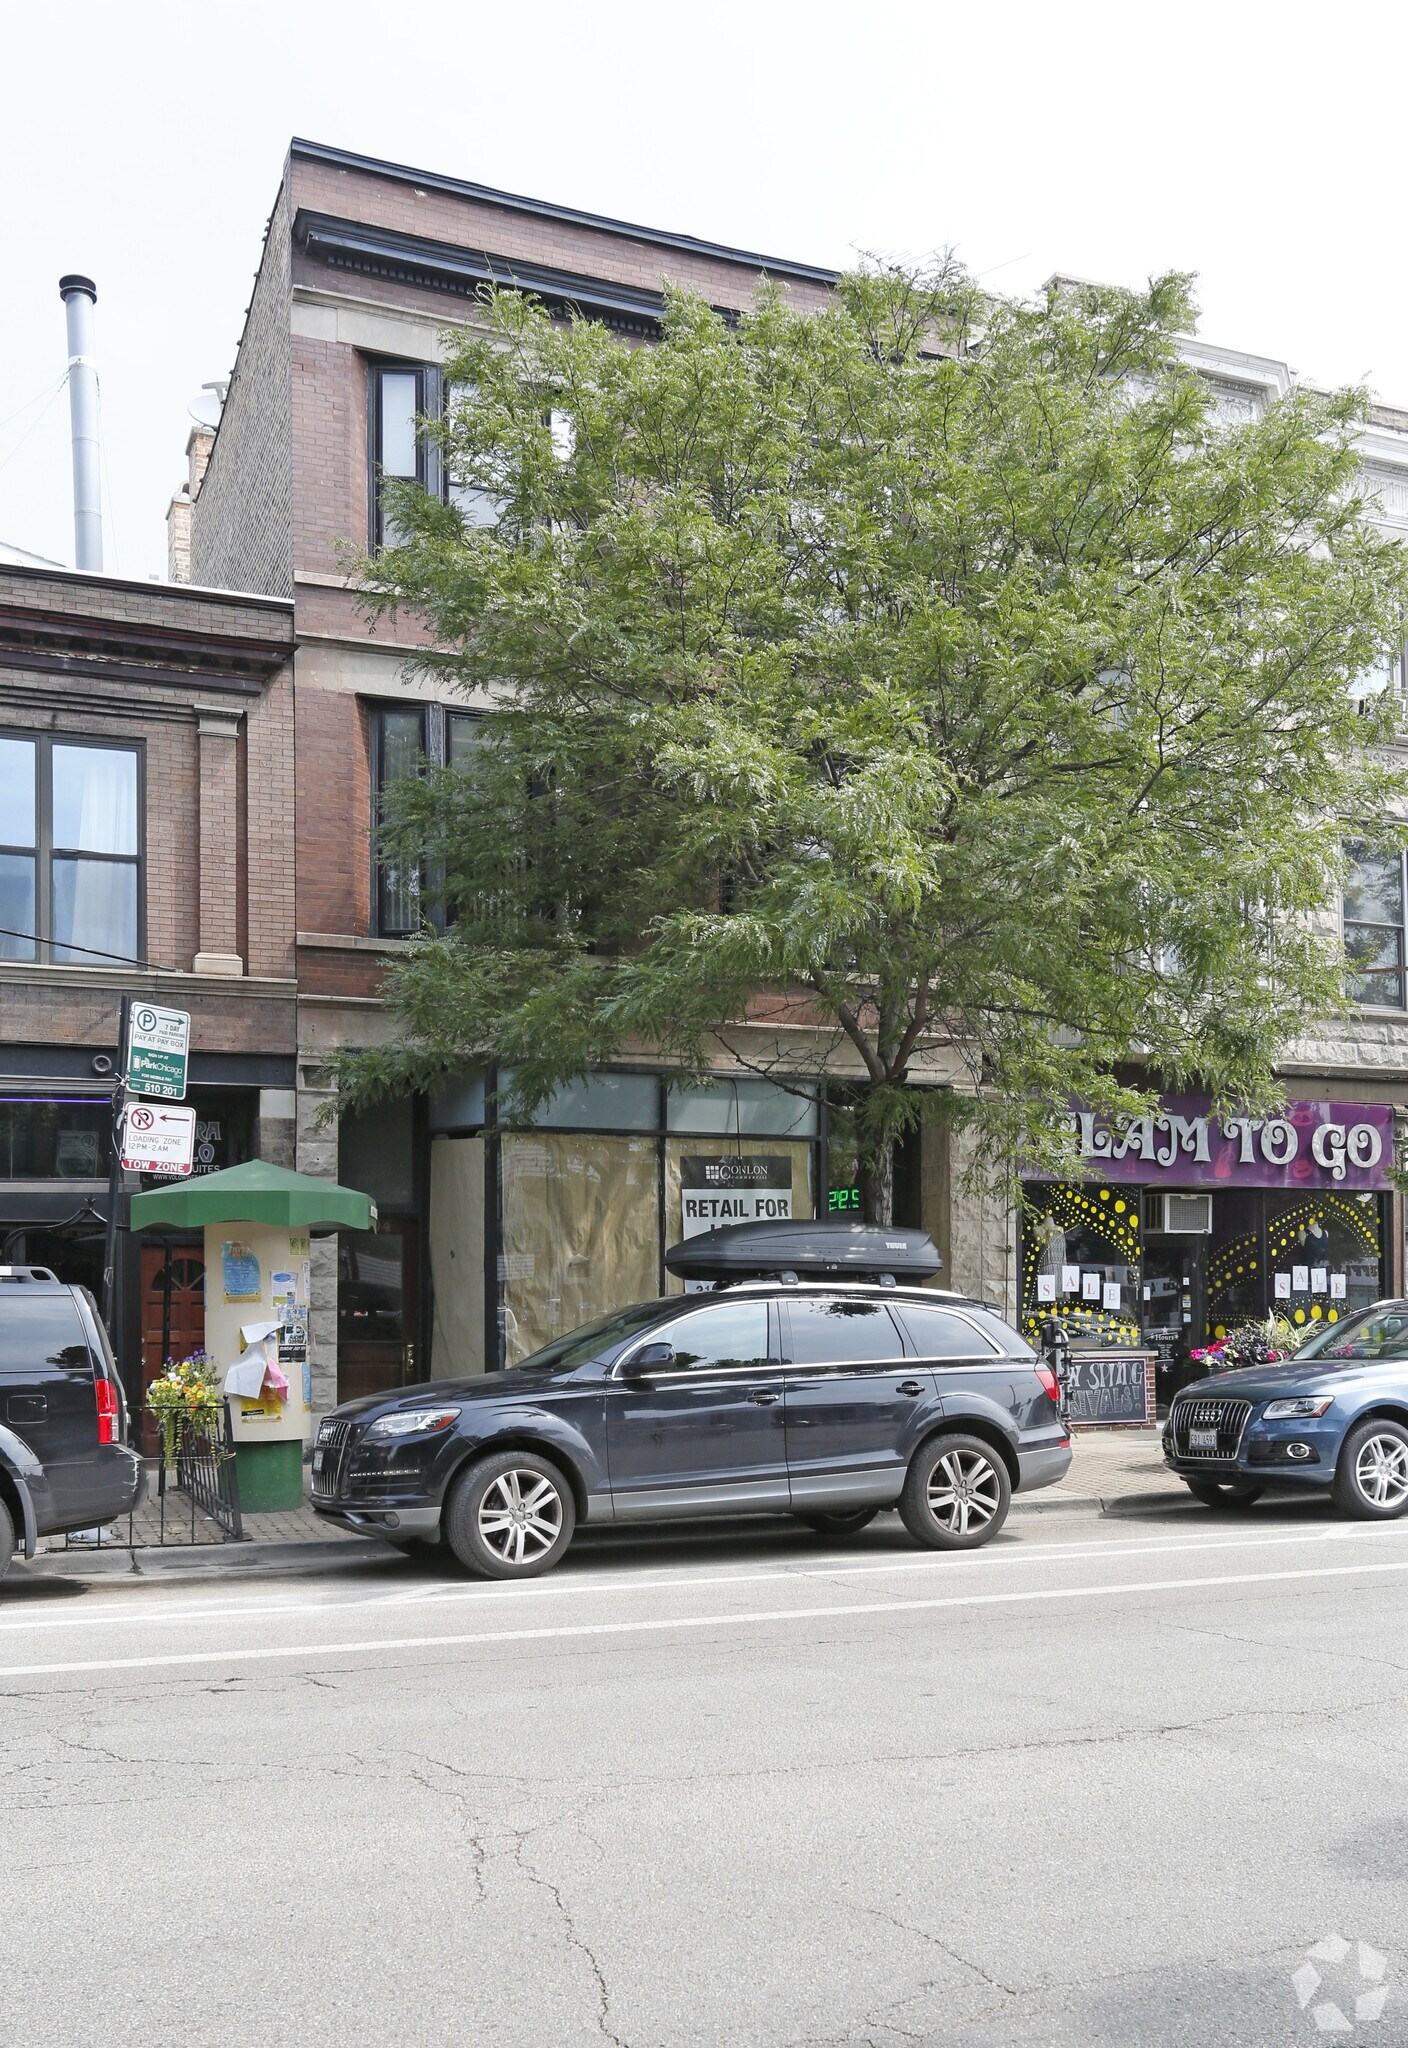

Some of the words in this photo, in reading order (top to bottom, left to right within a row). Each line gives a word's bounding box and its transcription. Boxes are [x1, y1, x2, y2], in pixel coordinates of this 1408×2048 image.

[169, 1031, 185, 1039] PARKING
[170, 1040, 184, 1048] BOX
[140, 1058, 182, 1075] ParkChicago
[144, 1083, 161, 1094] 510
[162, 1085, 177, 1096] 201
[128, 1135, 159, 1144] LOADING
[1223, 1117, 1299, 1166] TO
[1311, 1122, 1383, 1181] GO
[127, 1159, 151, 1170] TOW
[155, 1160, 185, 1173] ZONE
[192, 1164, 220, 1173] UITES
[720, 1165, 768, 1180] CONLON
[685, 1199, 749, 1218] RETAIL
[755, 1198, 789, 1218] FOR
[1155, 1333, 1175, 1341] Hours
[1069, 1386, 1142, 1417] RIVALS!
